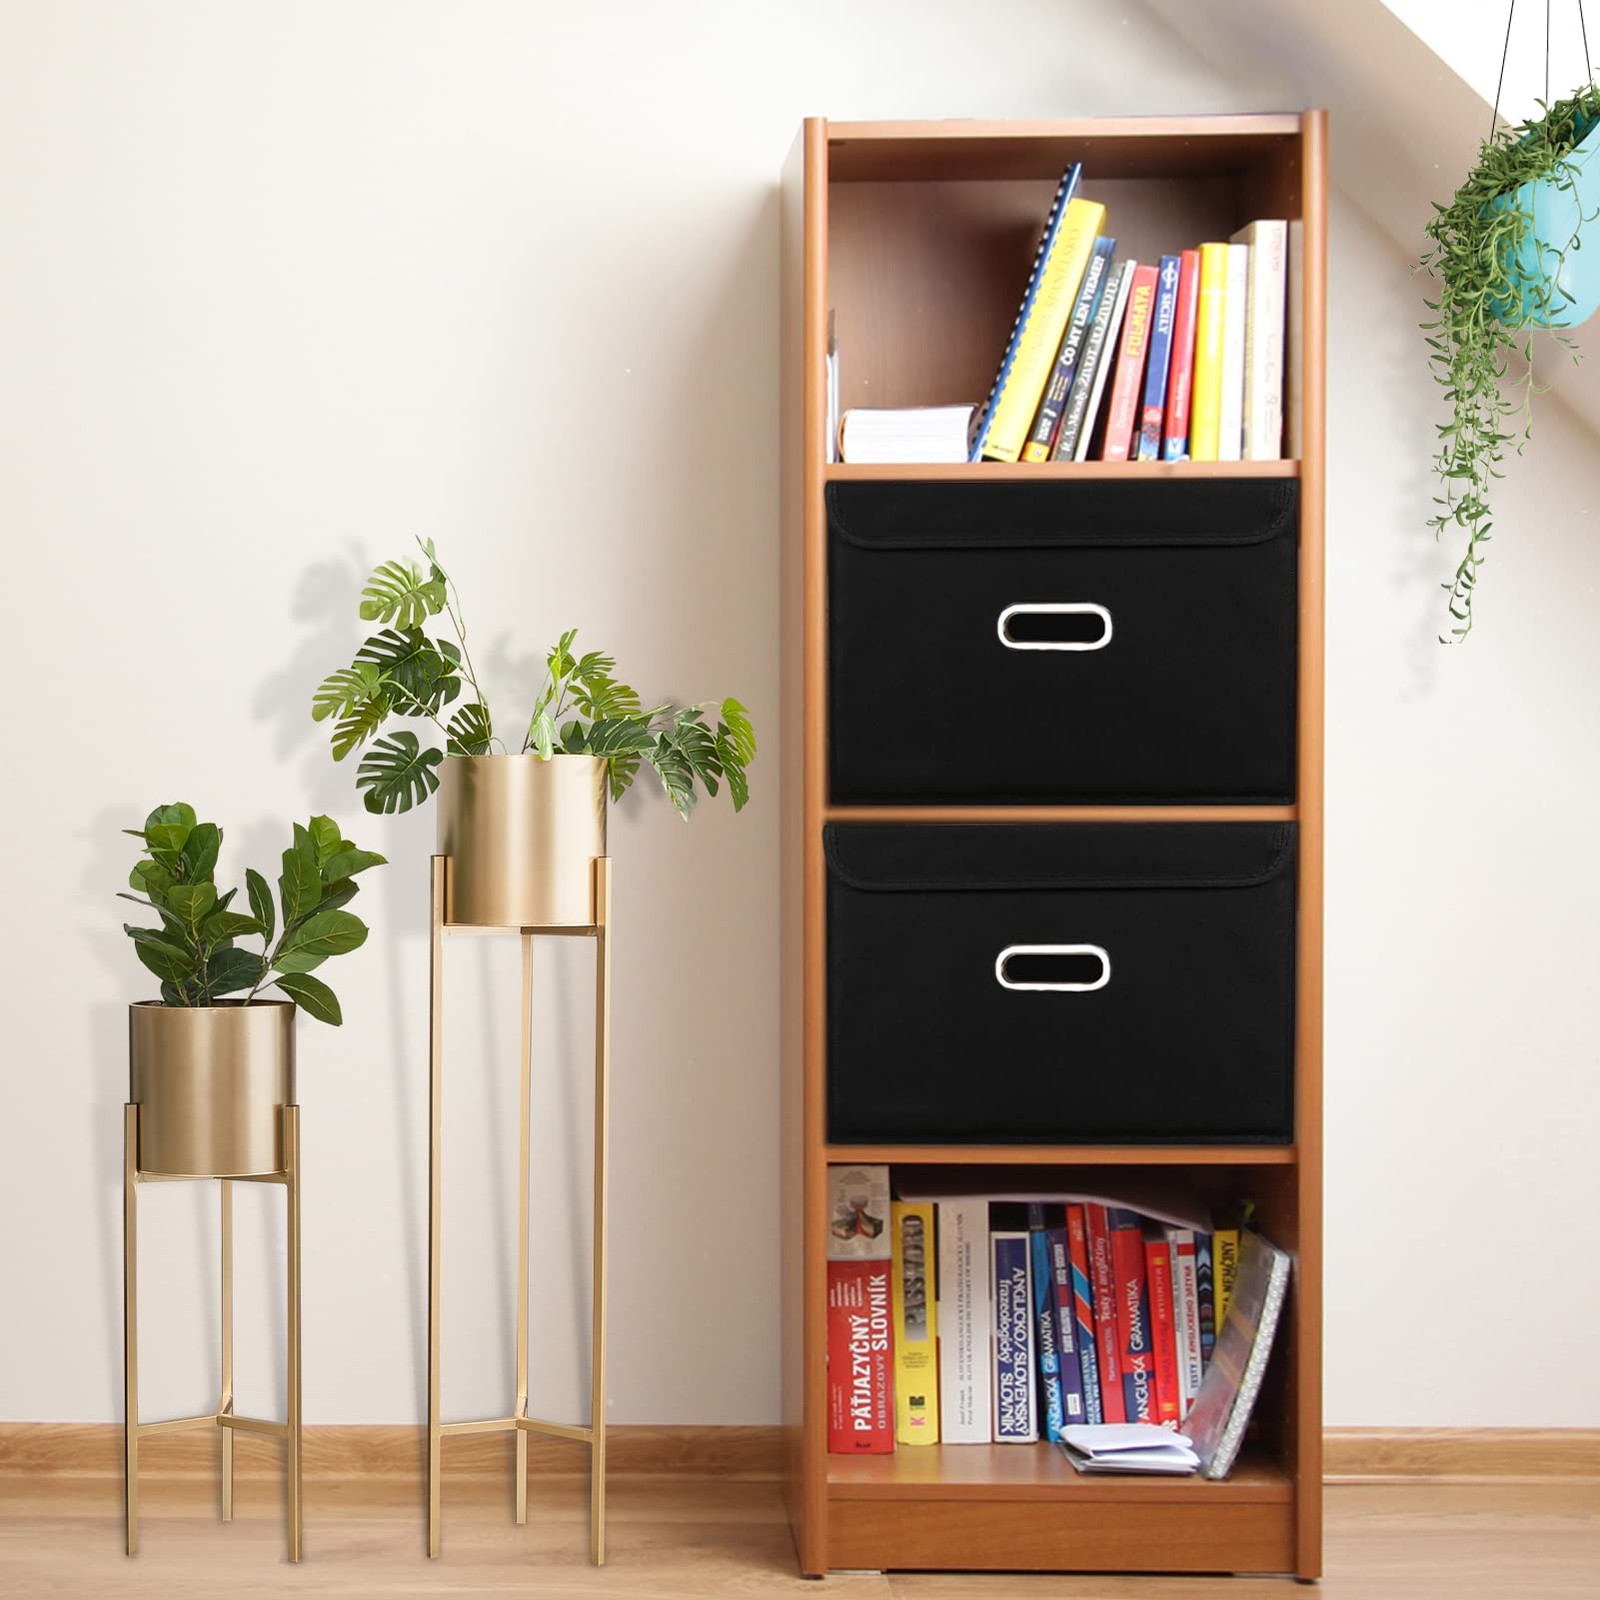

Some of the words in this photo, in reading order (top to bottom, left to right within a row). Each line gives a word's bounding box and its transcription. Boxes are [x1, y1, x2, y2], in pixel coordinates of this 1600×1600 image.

[1067, 330, 1083, 352] MY
[1073, 304, 1090, 331] LEN
[1158, 293, 1173, 334] SICILY
[1060, 346, 1076, 366] ČO
[903, 1215, 927, 1326] PASSWORD
[868, 1274, 888, 1350] SLOVNÍK
[997, 1279, 1014, 1365] frazeologický
[1100, 1294, 1112, 1323] Testy
[1127, 1279, 1144, 1351] GRAMATIKA
[849, 1314, 872, 1431] PÄŤJAZYČNÝ
[1041, 1310, 1055, 1373] GRAMATIKA
[1000, 1372, 1015, 1434] SLOVNÍK
[1046, 1376, 1062, 1433] ANGLICKÁ
[1131, 1355, 1150, 1421] ANGLICKÁ
